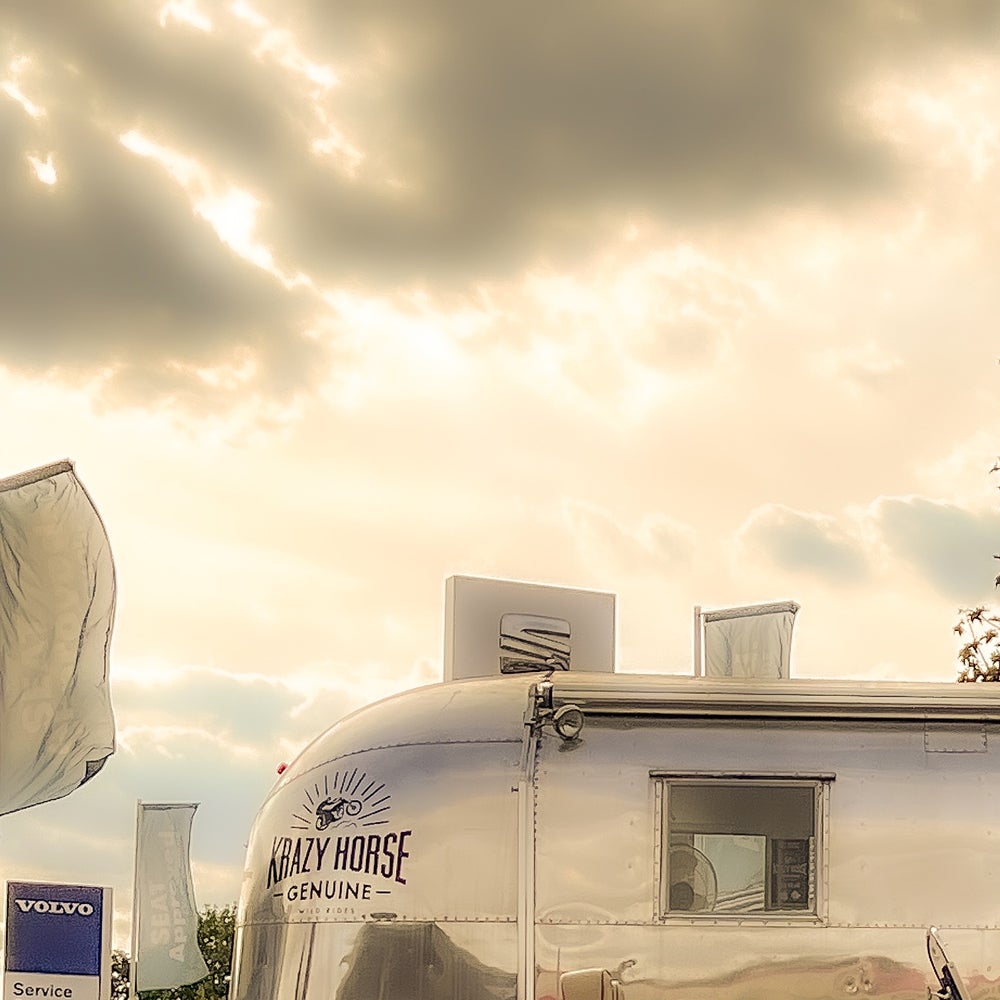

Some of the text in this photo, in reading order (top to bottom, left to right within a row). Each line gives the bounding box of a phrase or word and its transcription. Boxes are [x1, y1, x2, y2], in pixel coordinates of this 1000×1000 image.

[266, 830, 412, 889] KRAZY HORSE
[287, 880, 372, 901] GENUINE
[15, 899, 95, 916] VOLVO
[13, 982, 73, 998] Service
